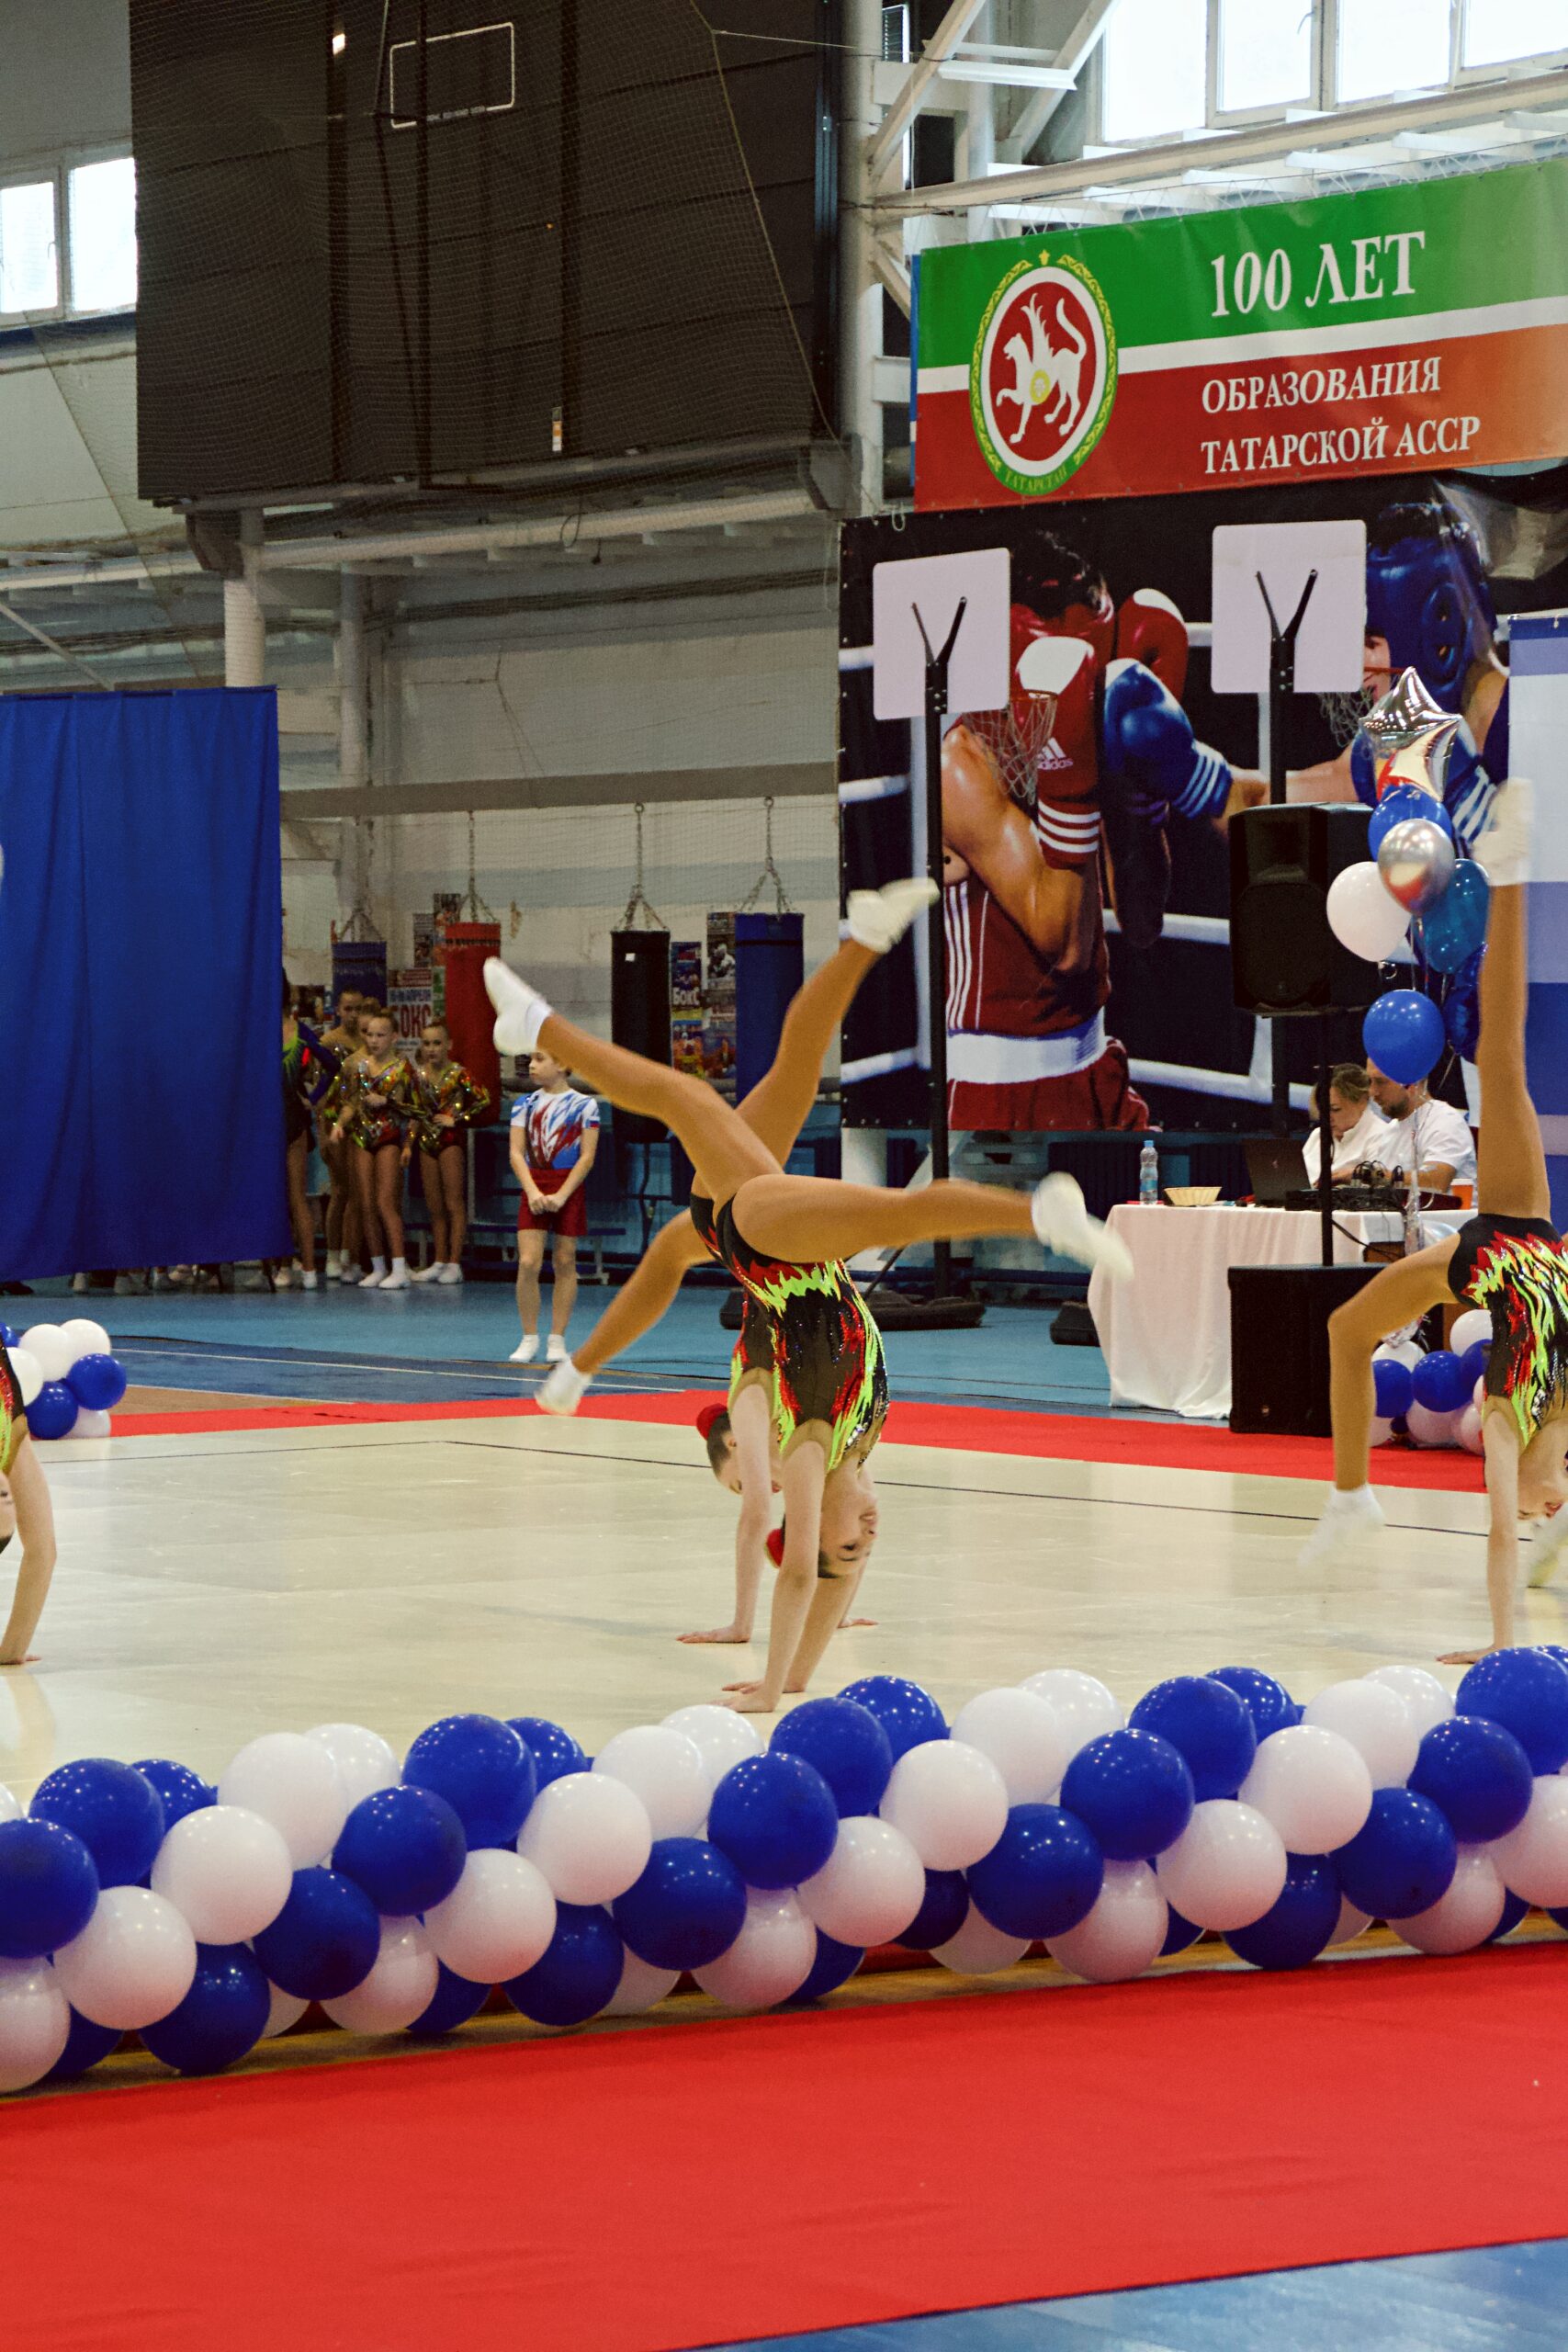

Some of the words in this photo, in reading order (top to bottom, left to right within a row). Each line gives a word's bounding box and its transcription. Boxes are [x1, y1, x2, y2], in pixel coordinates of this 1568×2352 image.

[1211, 248, 1292, 317] 100
[1304, 231, 1426, 308] ЛЕТ
[1201, 356, 1442, 414] ОБРАЗОВАНИЯ
[1201, 416, 1389, 474] ТАТАРСКОЙ
[1393, 416, 1481, 458] АССР
[1033, 758, 1074, 771] didas
